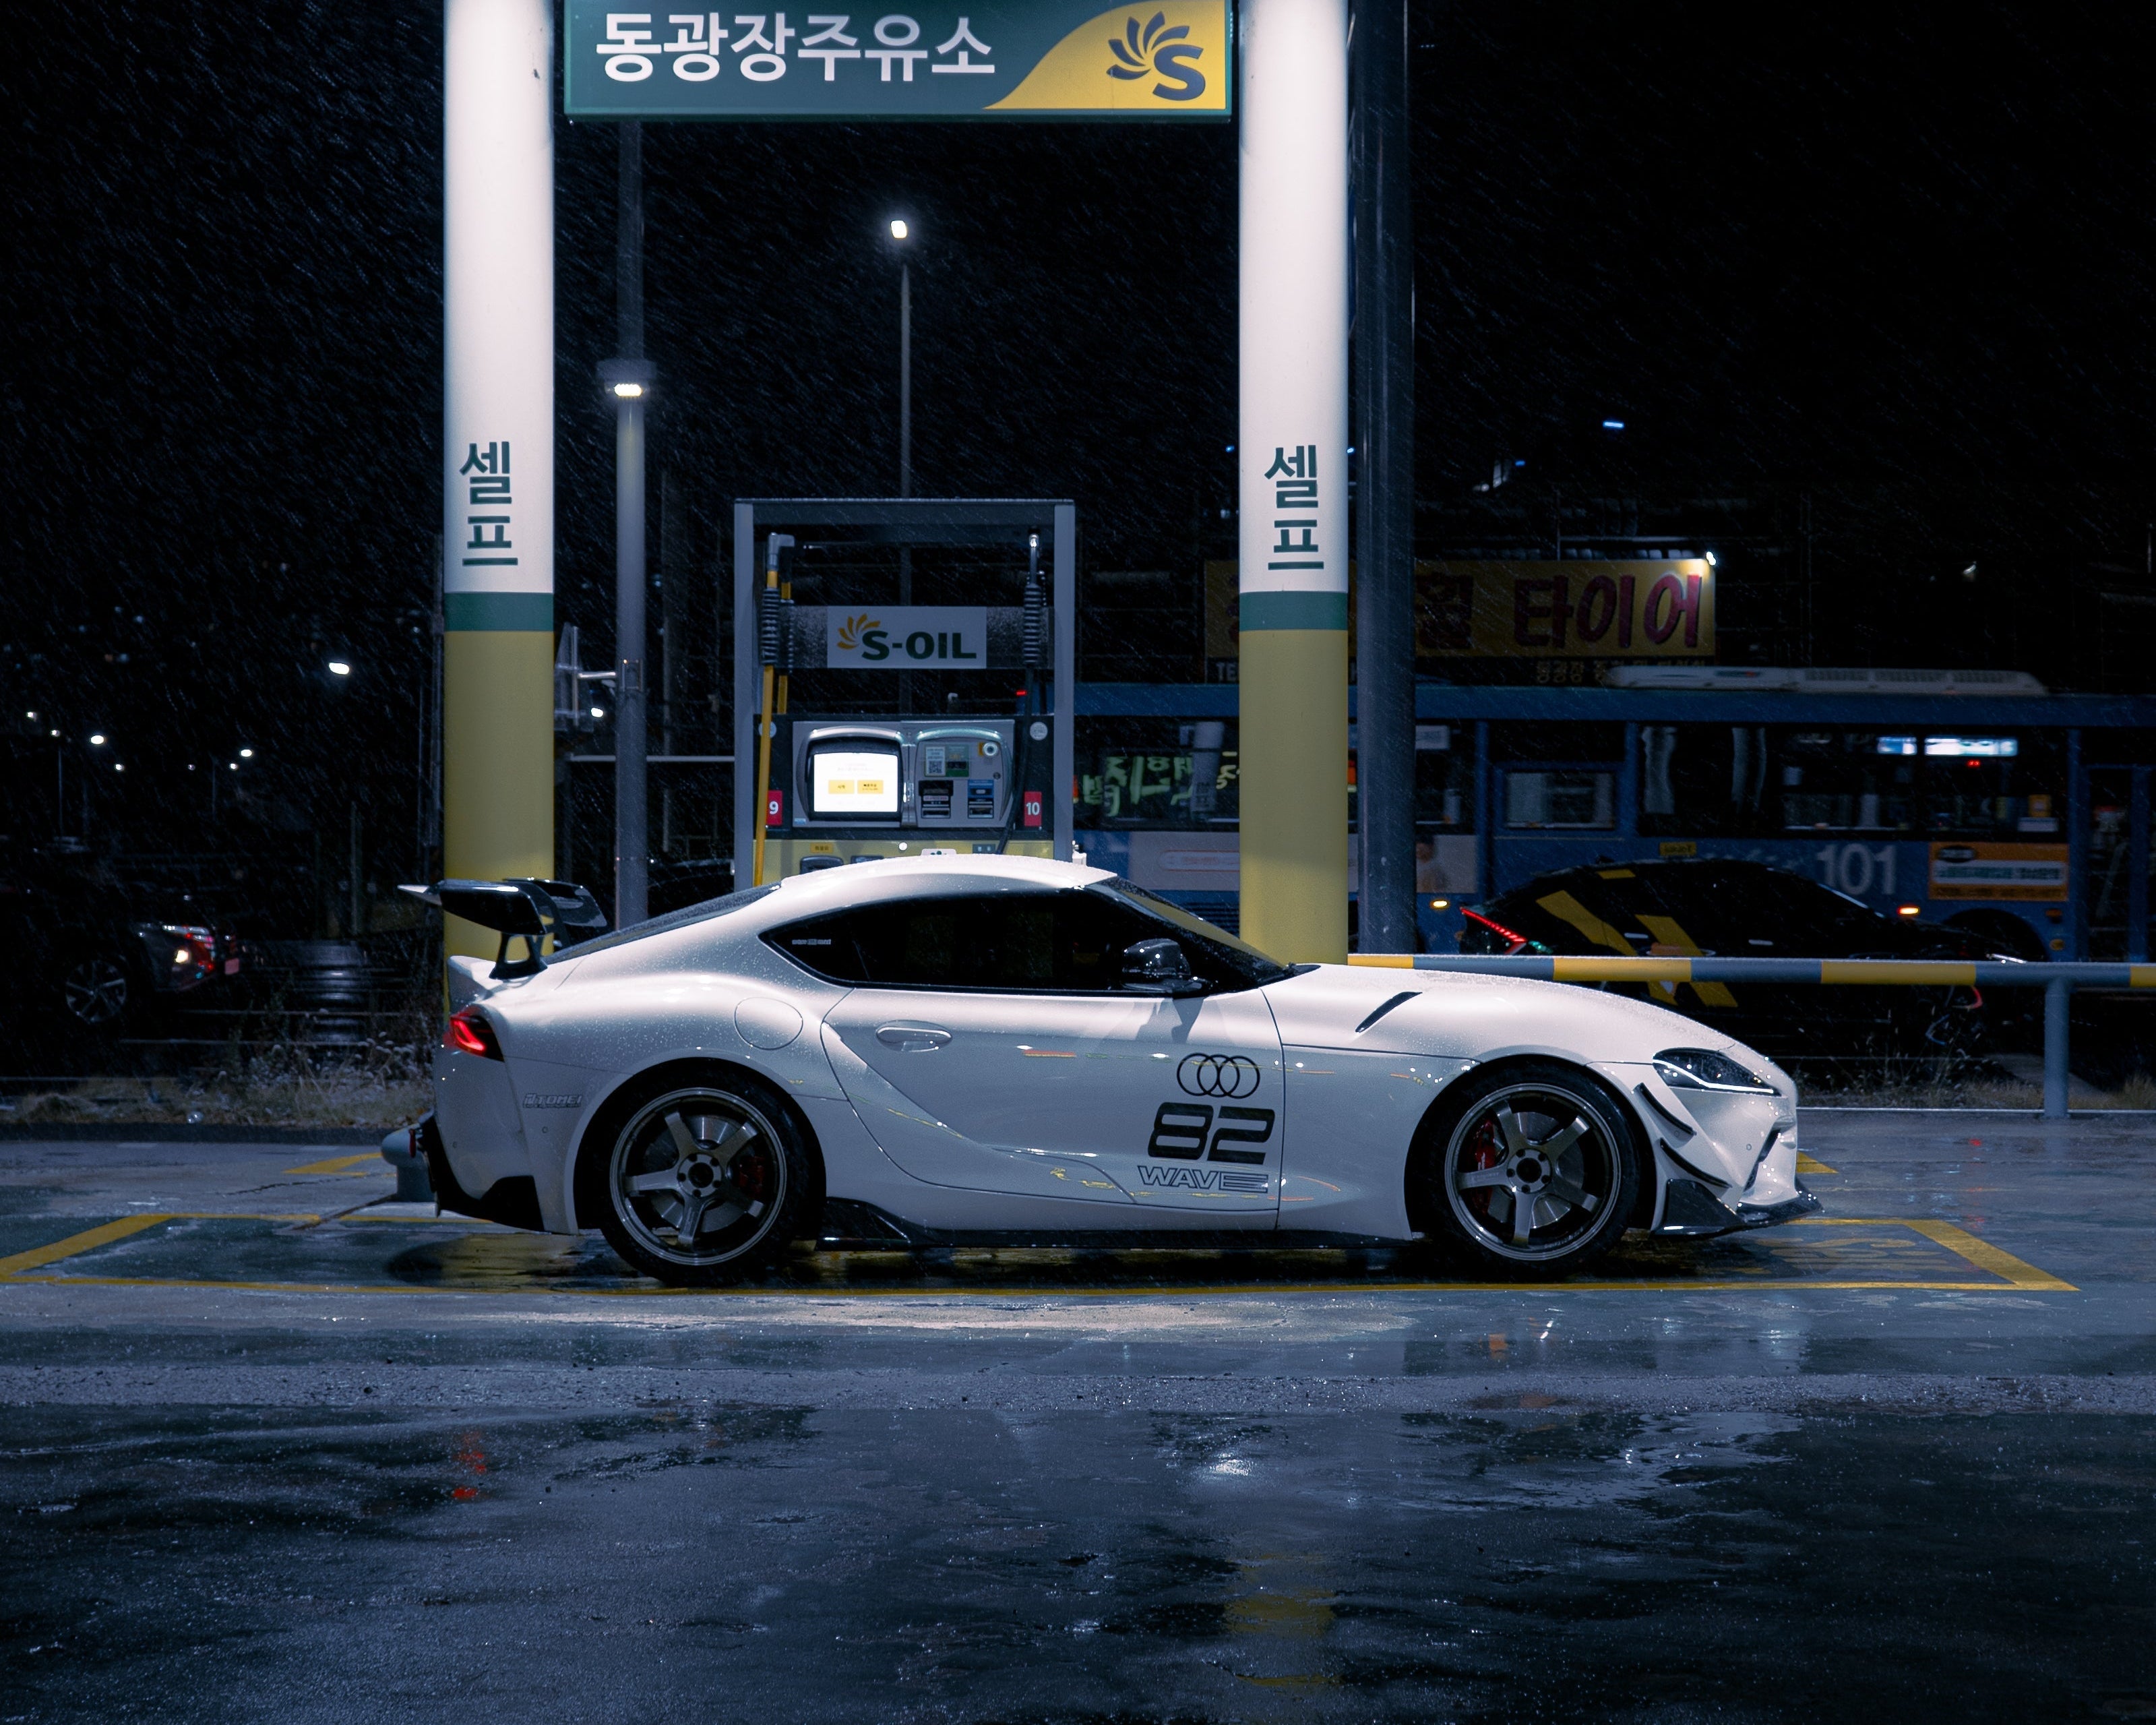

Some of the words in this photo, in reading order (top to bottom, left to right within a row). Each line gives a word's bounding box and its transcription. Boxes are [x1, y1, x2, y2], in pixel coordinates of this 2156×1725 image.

[596, 11, 995, 82] 동광장주유소
[459, 442, 518, 566] 셀프
[1264, 445, 1324, 570] 셀프
[1515, 575, 1702, 648] 타이어
[861, 630, 977, 661] S-OIL
[769, 801, 778, 814] 9
[1026, 802, 1040, 816] 10
[1816, 843, 1897, 895] 101
[1148, 1102, 1275, 1165] 82
[1138, 1166, 1268, 1193] WAVE
